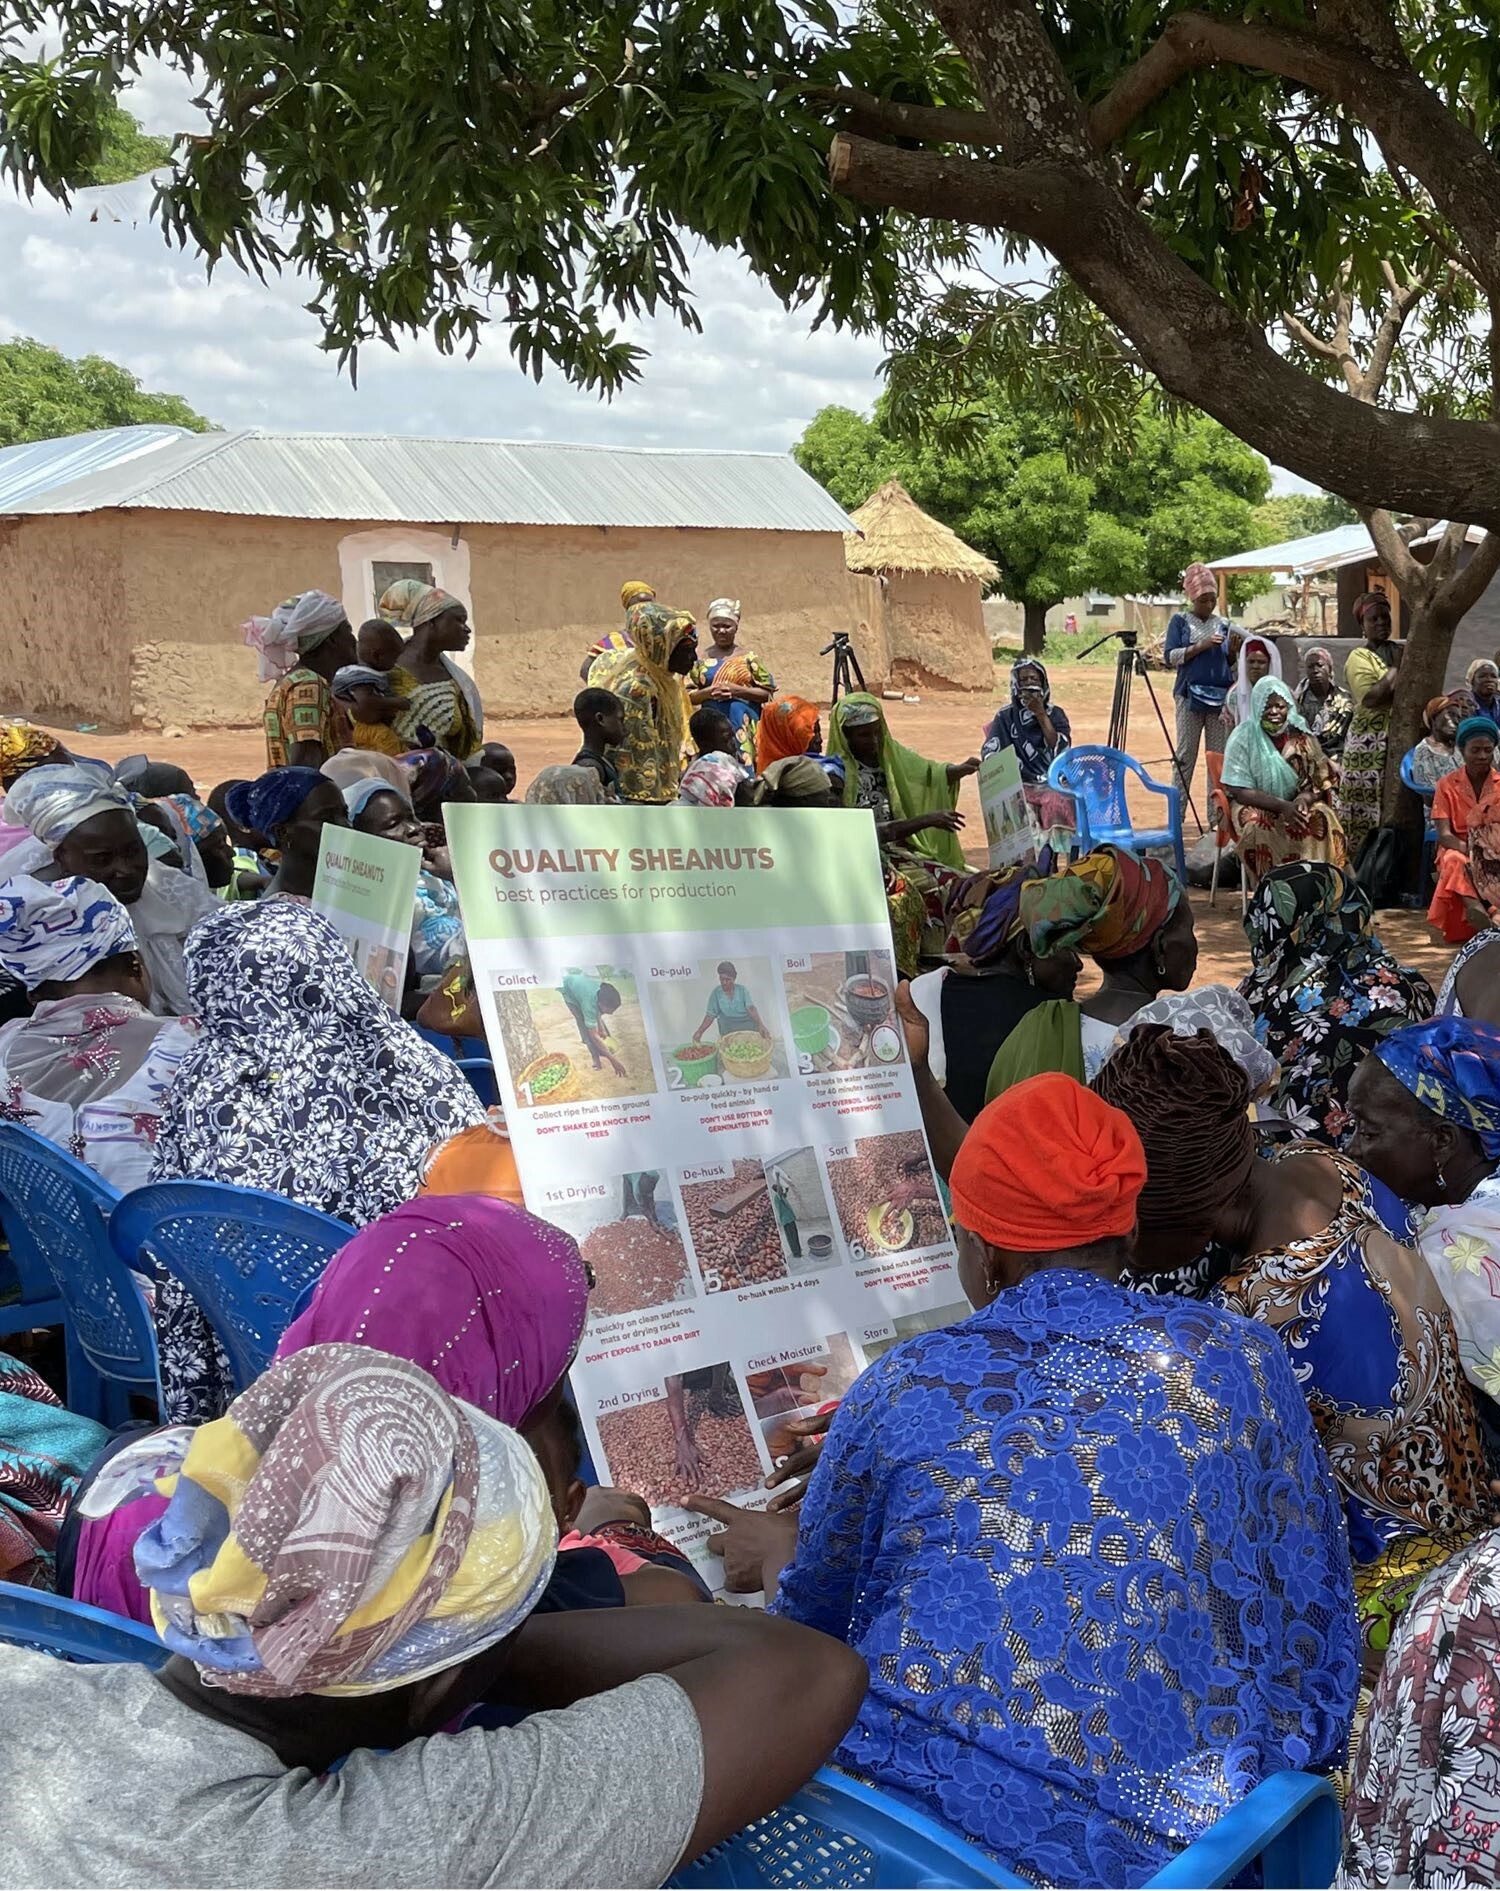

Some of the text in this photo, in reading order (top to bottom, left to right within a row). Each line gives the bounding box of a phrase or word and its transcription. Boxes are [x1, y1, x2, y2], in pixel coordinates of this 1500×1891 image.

[325, 851, 385, 883] QUALITY SHEANUTS
[489, 847, 774, 879] QUALITY SHEANUTS
[495, 882, 736, 905] best practices for production
[651, 966, 692, 977] De-pulp
[787, 958, 805, 968] Boil
[498, 974, 539, 986] Collect
[799, 1051, 814, 1074] 3
[667, 1066, 686, 1090] 2
[518, 1081, 534, 1106] 1
[680, 1093, 710, 1103] De-pulp
[711, 1089, 737, 1101] quickly
[743, 1087, 752, 1096] by
[753, 1085, 770, 1094] hand
[816, 1081, 894, 1097] for 40 minutes maximum
[532, 1100, 650, 1121] Collect ripe fruit from ground
[711, 1098, 755, 1110] feed animals
[536, 1115, 651, 1135] DON'T SHAKE OR KNOCK FROM
[700, 1115, 721, 1125] DON'T
[722, 1113, 737, 1122] USE
[738, 1110, 763, 1119] ROTTEN
[708, 1119, 769, 1134] GERMINATED NUTS
[585, 1130, 609, 1139] TREES
[828, 1145, 849, 1158] Sort
[683, 1165, 725, 1180] De-husk
[545, 1184, 606, 1202] 1st Drying
[849, 1238, 865, 1261] 6
[855, 1250, 954, 1278] Remove bad nuts and impurities
[705, 1268, 722, 1294] 5
[738, 1278, 820, 1301] De-husk within 3-4 days
[595, 1321, 625, 1336] quickly
[626, 1319, 637, 1327] on
[638, 1314, 659, 1325] clean
[661, 1306, 695, 1320] surfaces,
[600, 1321, 680, 1345] mats or drying racks
[864, 1327, 889, 1340] Store
[585, 1329, 701, 1363] DON'T EXPOSE TO RAIN OR DIRT
[748, 1343, 823, 1370] Check Moisture
[598, 1386, 660, 1410] 2nd Drying
[676, 1525, 685, 1533] to
[687, 1520, 700, 1530] dry
